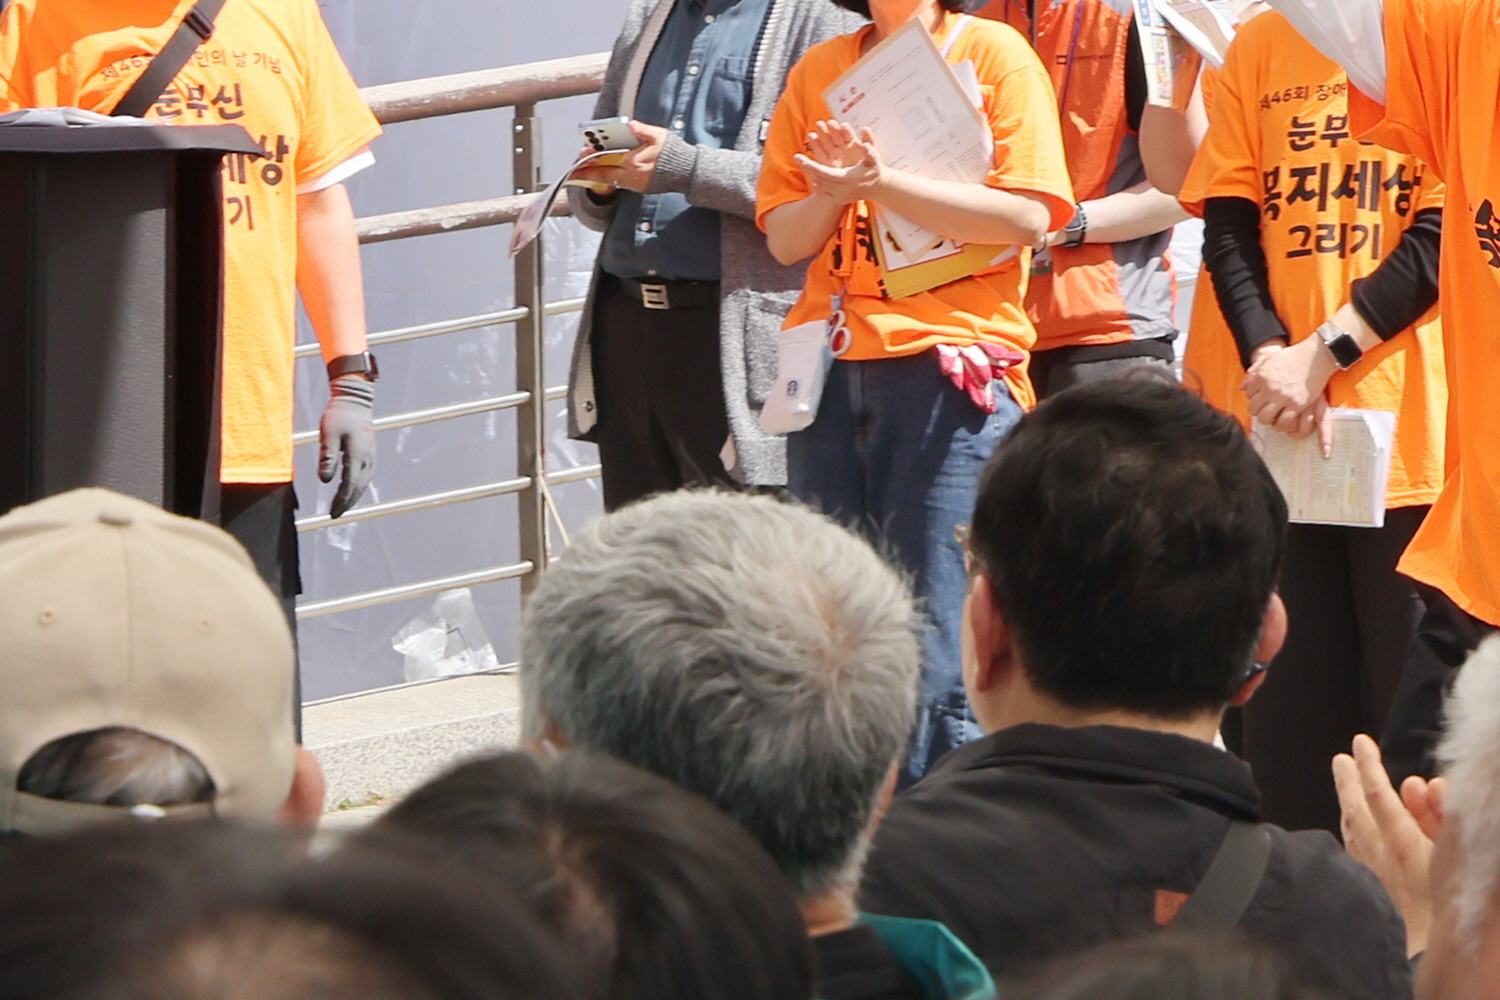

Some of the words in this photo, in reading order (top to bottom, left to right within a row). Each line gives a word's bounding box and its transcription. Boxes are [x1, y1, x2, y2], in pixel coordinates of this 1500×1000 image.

[1317, 83, 1347, 101] 장애
[1287, 114, 1376, 152] 눈부
[1286, 222, 1381, 260] 그리기
